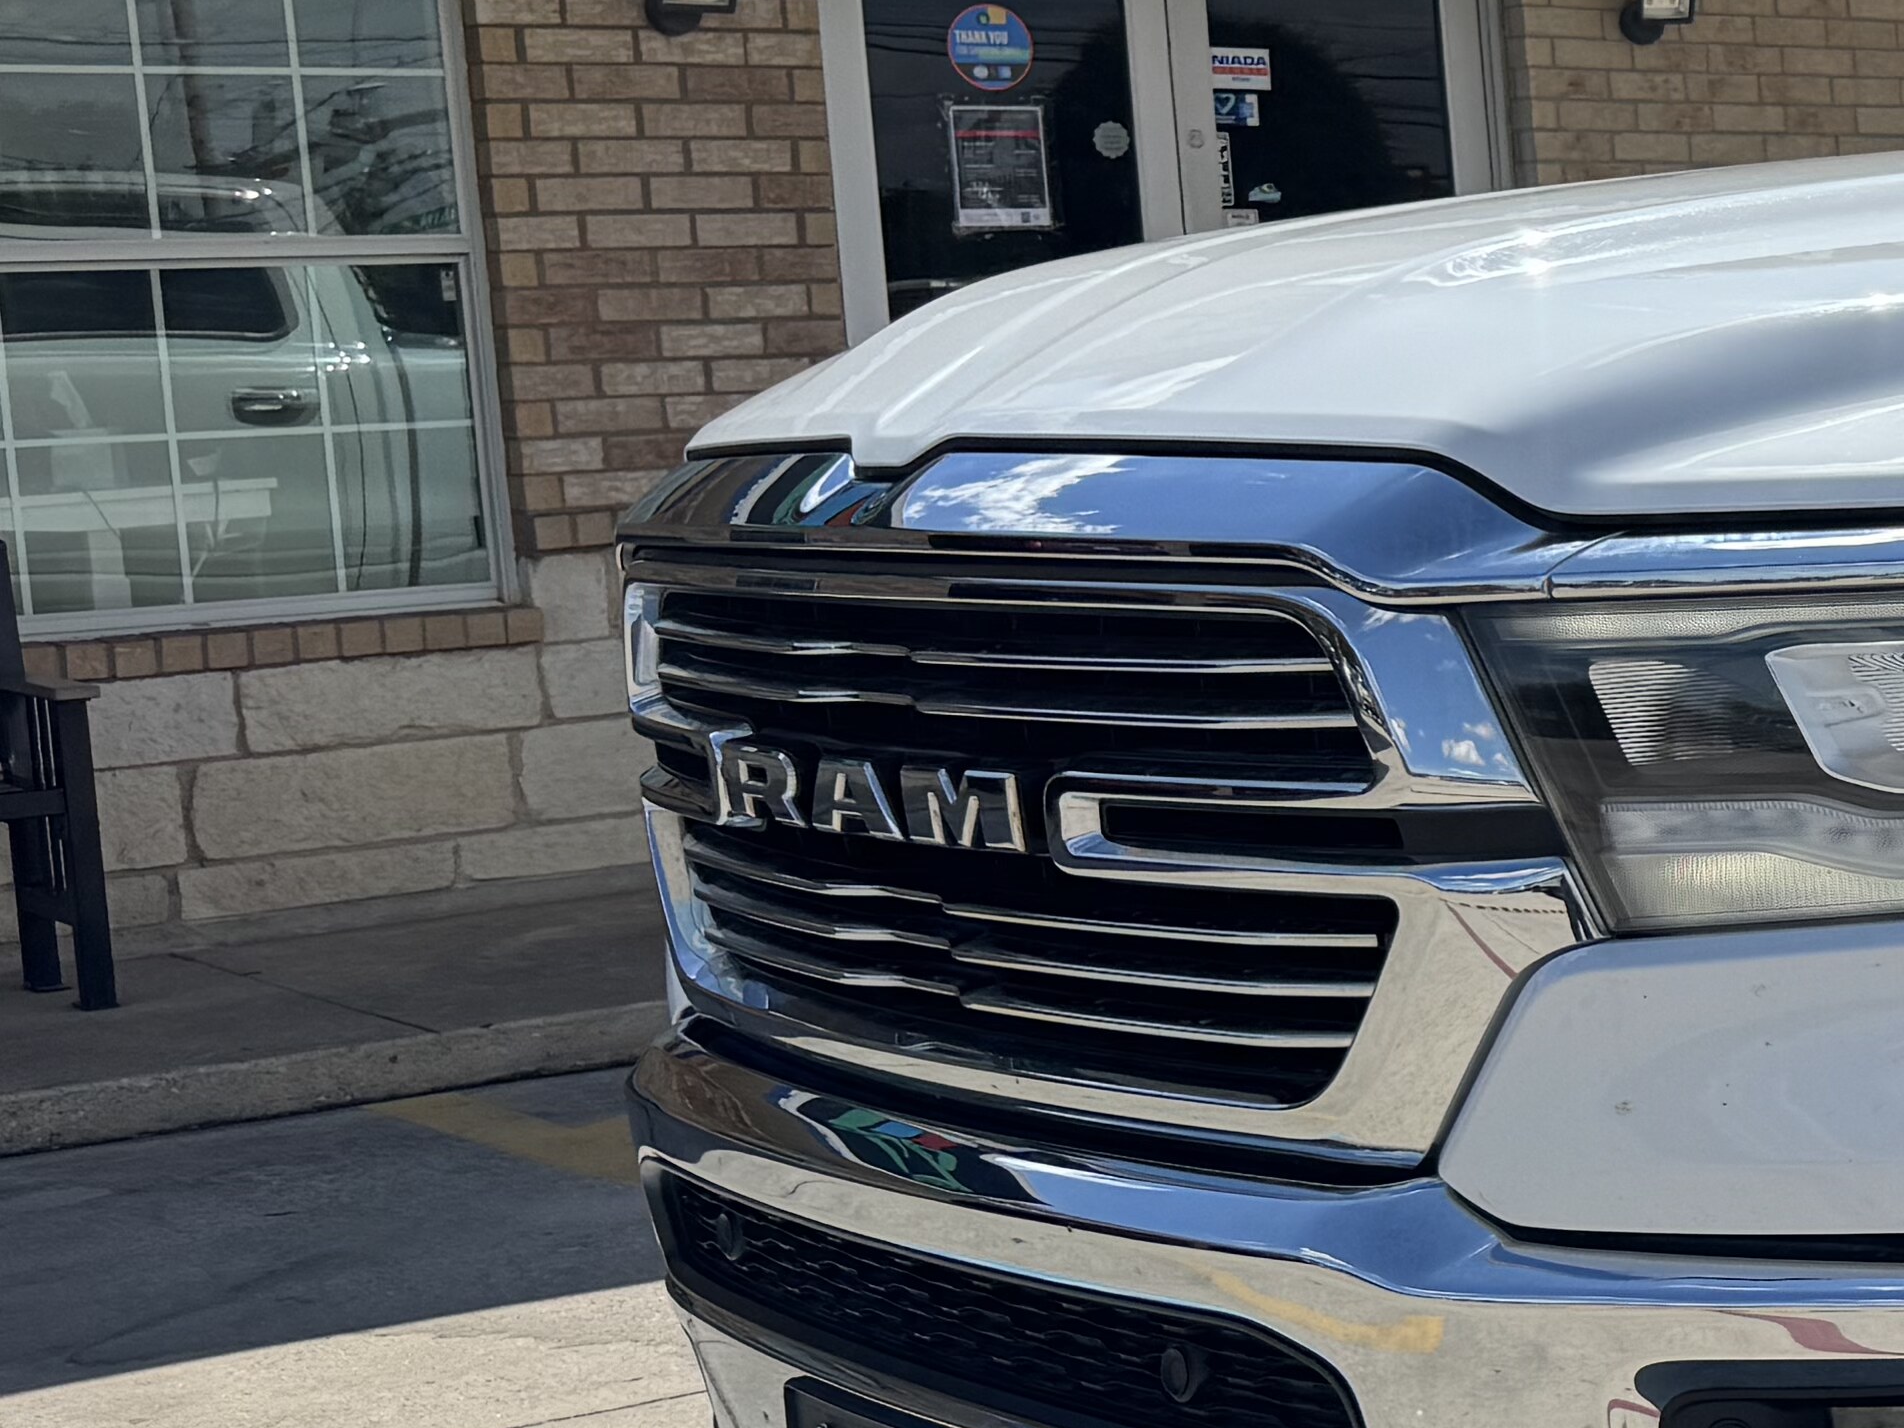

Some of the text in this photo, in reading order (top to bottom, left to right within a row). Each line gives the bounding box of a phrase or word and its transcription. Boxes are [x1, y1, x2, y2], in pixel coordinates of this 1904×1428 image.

[953, 29, 1009, 45] THANK YOU
[1211, 54, 1267, 66] NIADA
[719, 745, 1028, 853] RAM
